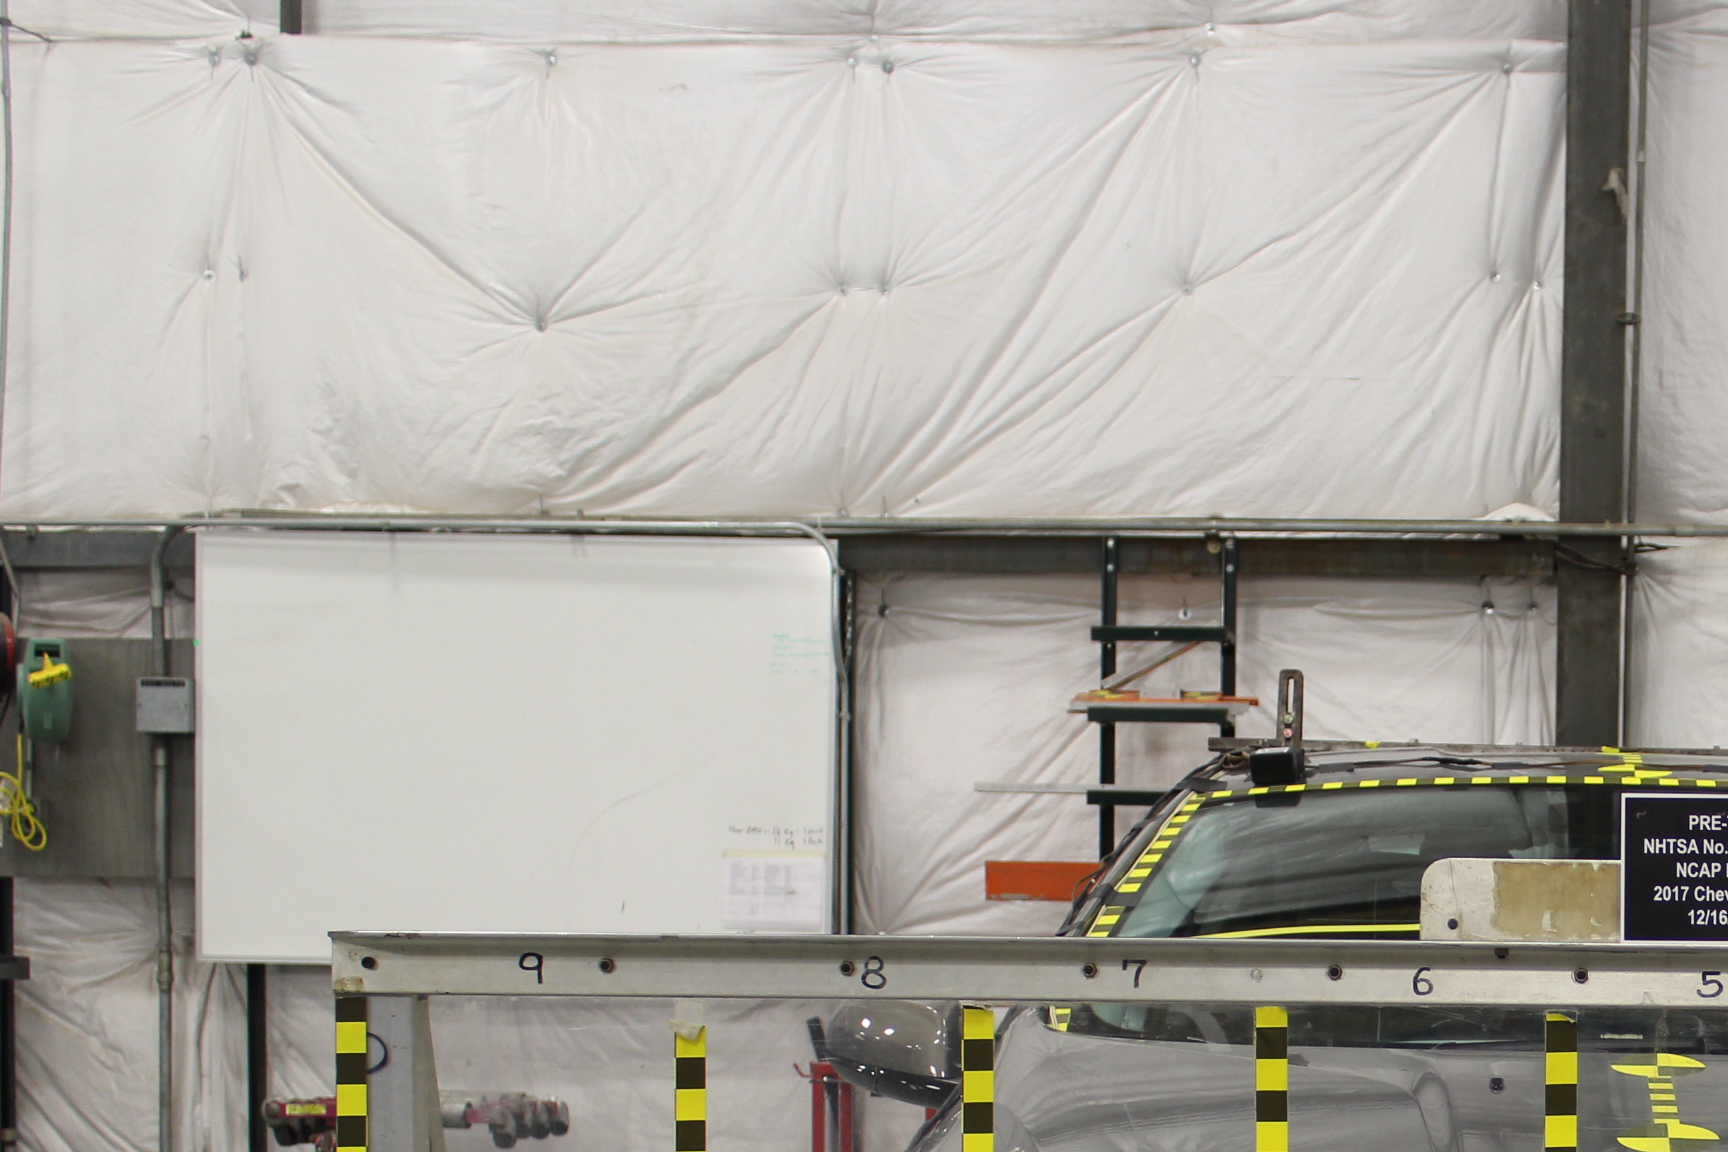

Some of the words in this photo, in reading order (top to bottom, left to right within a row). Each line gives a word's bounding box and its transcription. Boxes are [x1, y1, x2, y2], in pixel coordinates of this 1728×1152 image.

[1643, 838, 1699, 854] NHTSA
[1676, 862, 1721, 878] NCAP
[1653, 885, 1690, 901] 2017
[518, 952, 544, 985] 9
[861, 955, 887, 990] 8
[1121, 959, 1148, 988] 7
[1412, 967, 1434, 996] 6
[1695, 970, 1724, 998] 5
